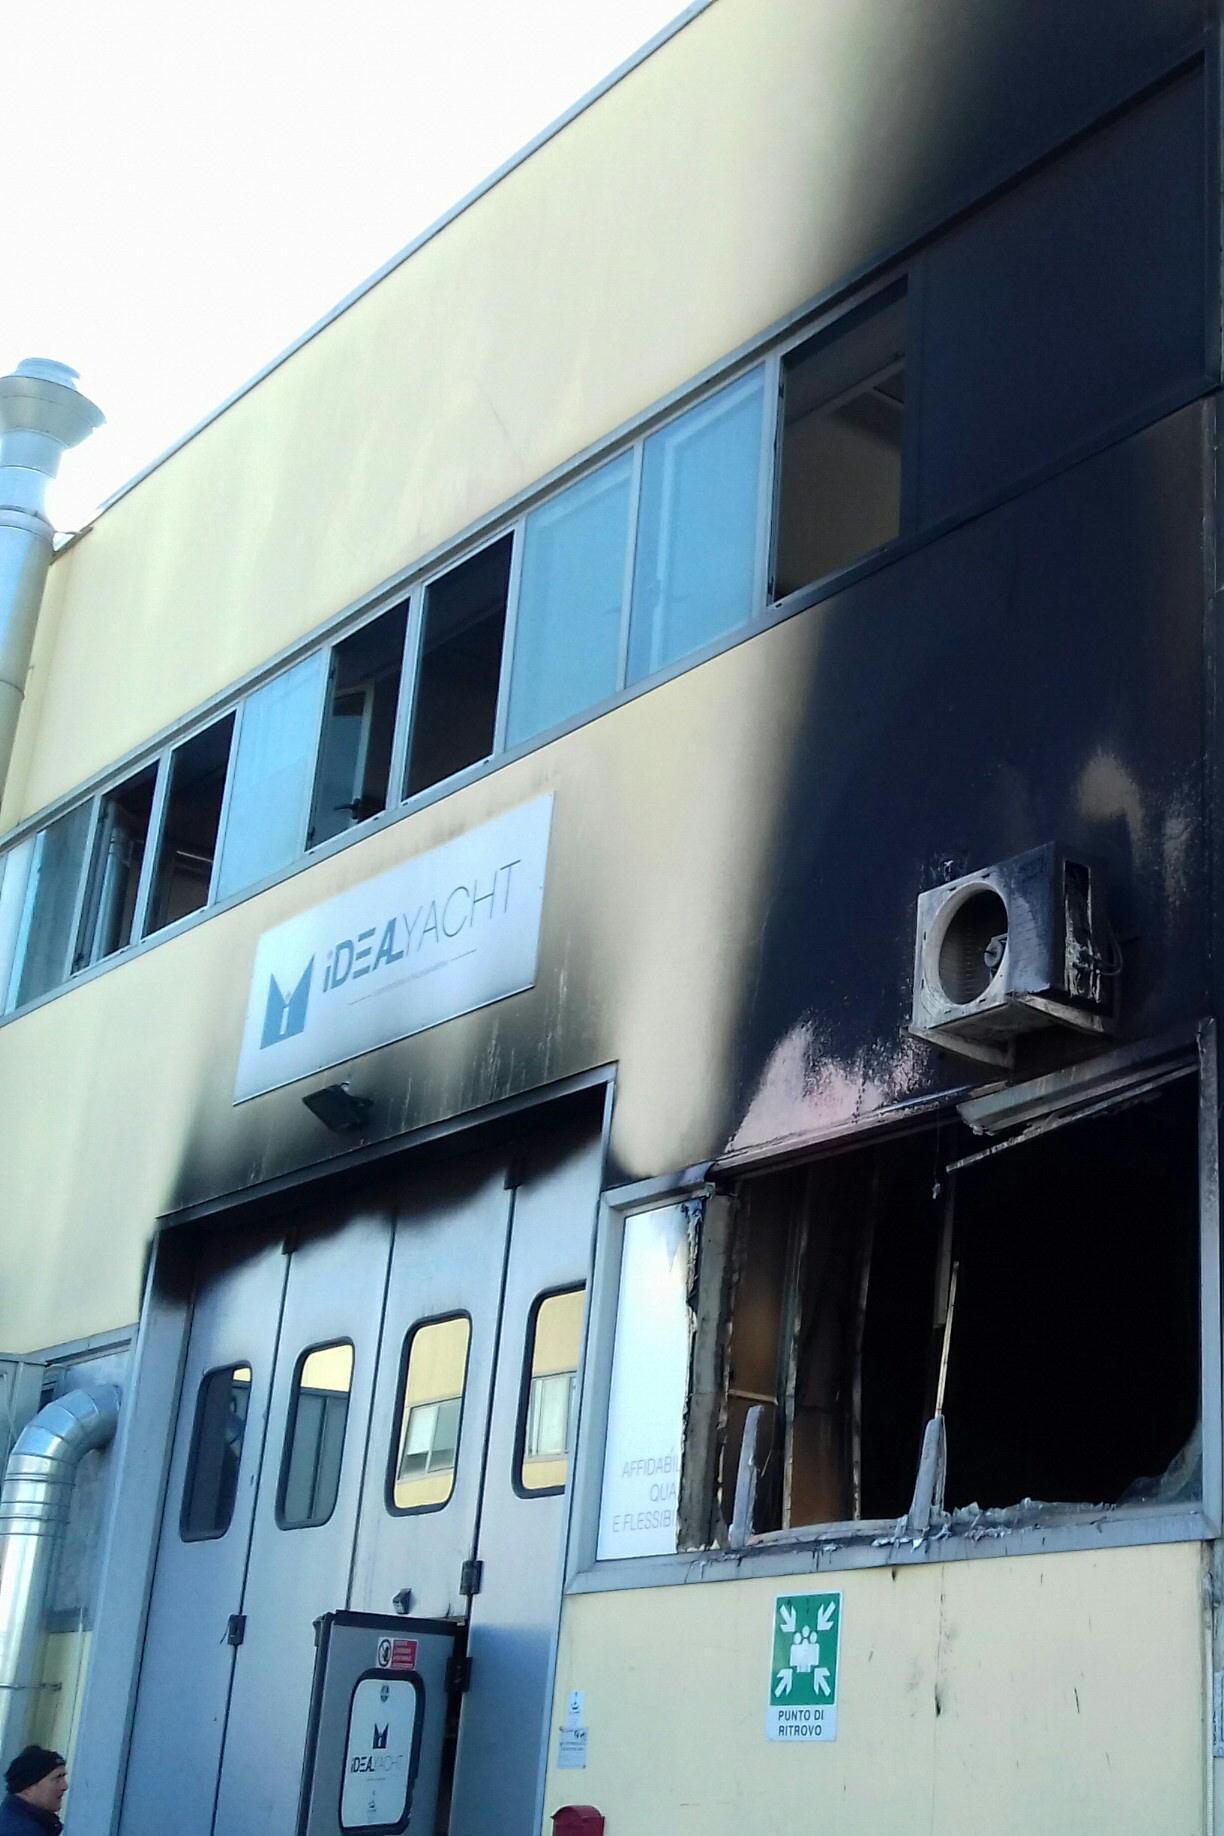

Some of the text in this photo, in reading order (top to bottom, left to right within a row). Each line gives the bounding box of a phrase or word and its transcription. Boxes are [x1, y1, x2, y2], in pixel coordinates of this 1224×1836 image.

[650, 1484, 677, 1502] QUA
[613, 1515, 622, 1532] E
[778, 1709, 824, 1721] PUNTO DI
[778, 1725, 822, 1737] RITROVO
